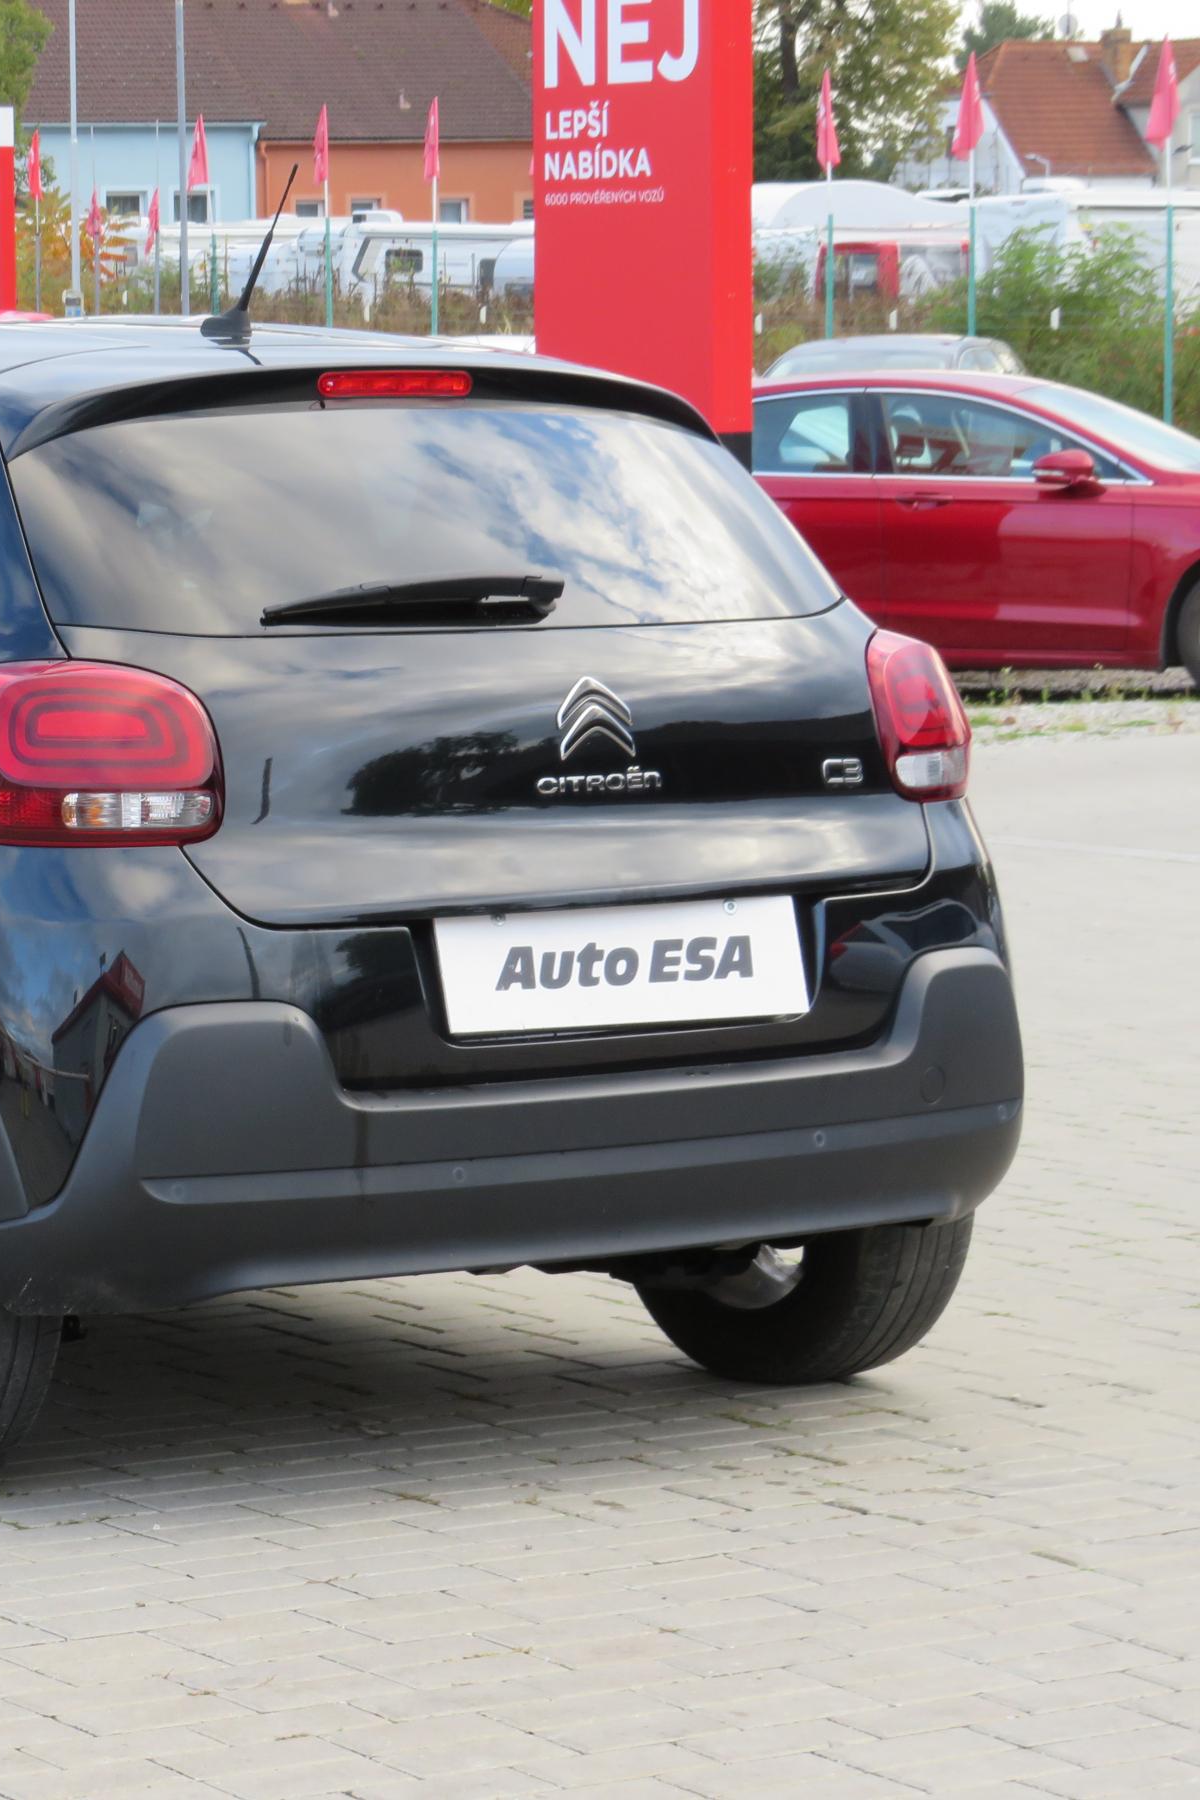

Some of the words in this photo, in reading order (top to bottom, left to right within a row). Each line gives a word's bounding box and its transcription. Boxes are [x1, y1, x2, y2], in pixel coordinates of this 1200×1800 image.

[543, 0, 700, 89] NEJ
[545, 100, 609, 140] LEPŠÍ
[544, 143, 652, 180] NABÍDKA
[545, 192, 568, 206] 6000
[822, 757, 864, 784] C3
[495, 942, 639, 991] Auto
[648, 935, 754, 983] ESA
